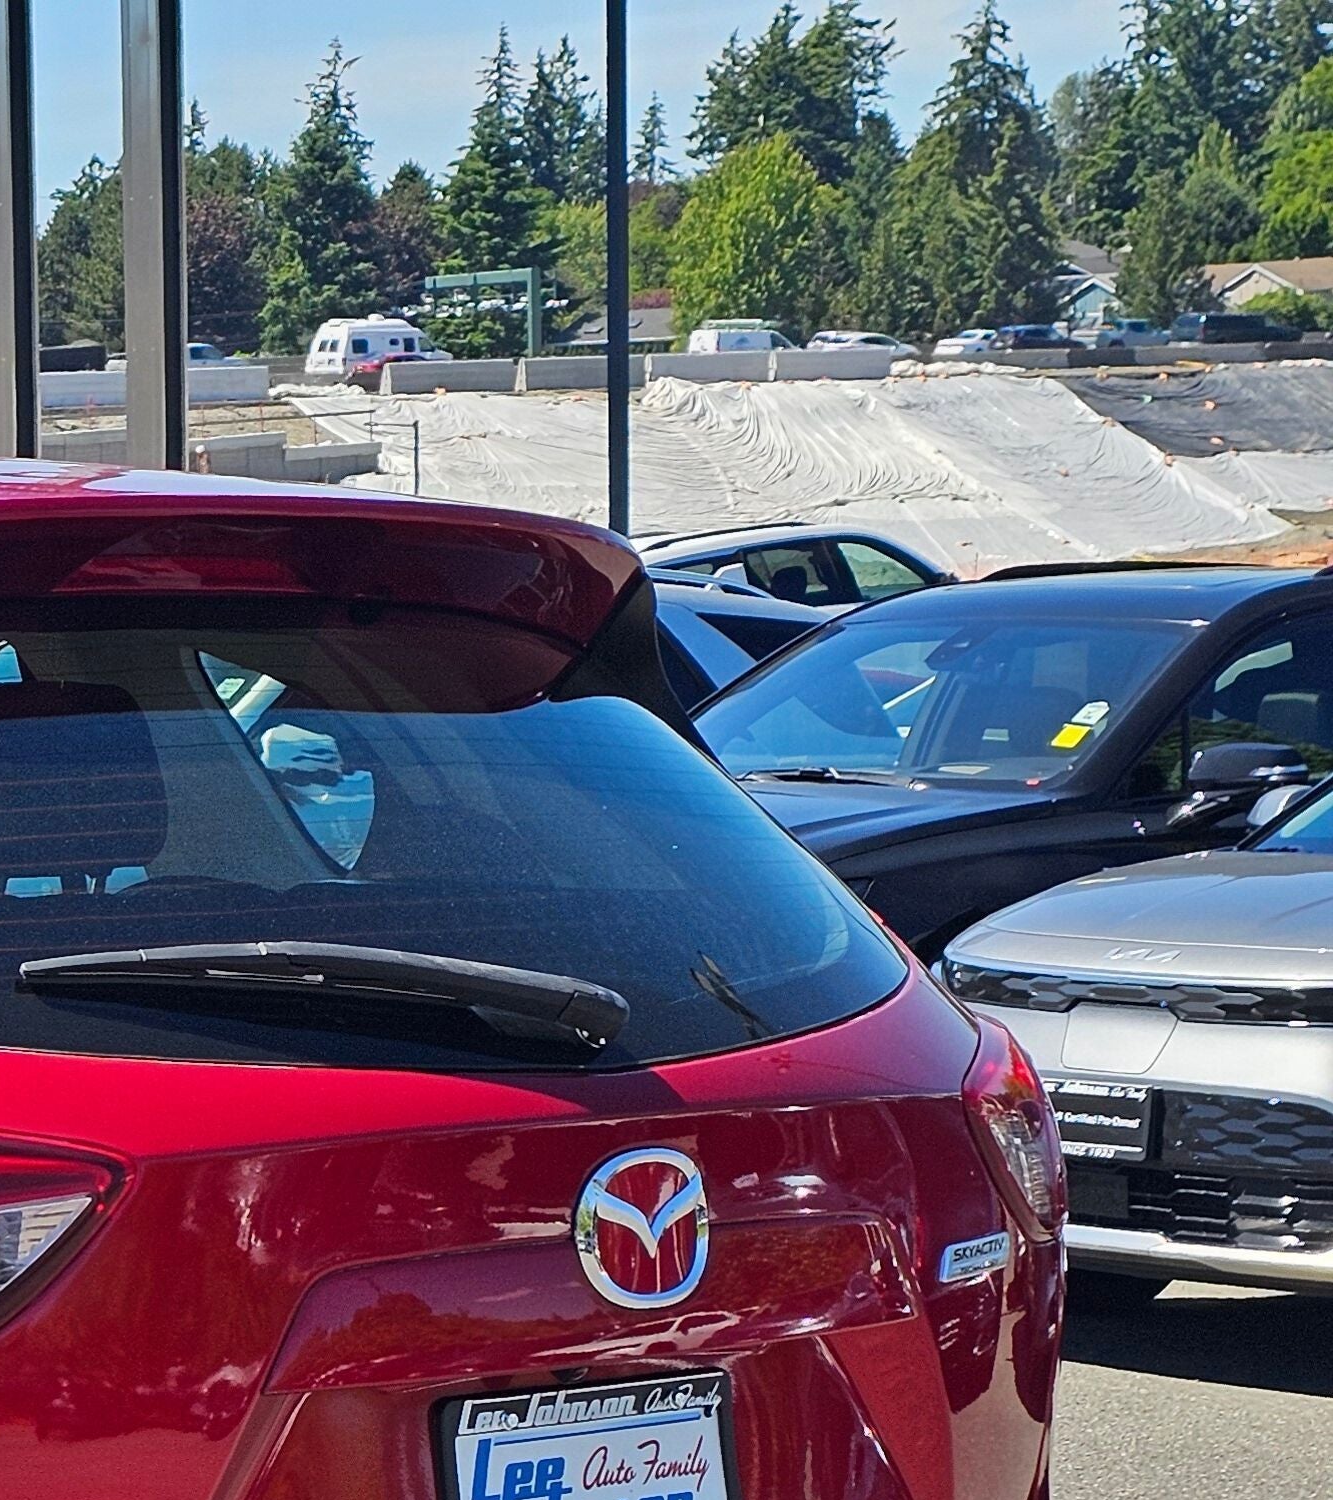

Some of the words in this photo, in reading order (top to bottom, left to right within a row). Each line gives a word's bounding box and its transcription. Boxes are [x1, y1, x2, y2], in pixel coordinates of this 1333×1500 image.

[953, 1237, 1005, 1262] SKYACTIV
[517, 1390, 638, 1427] Johnson
[583, 1446, 636, 1490] Auto
[637, 1434, 710, 1492] Family
